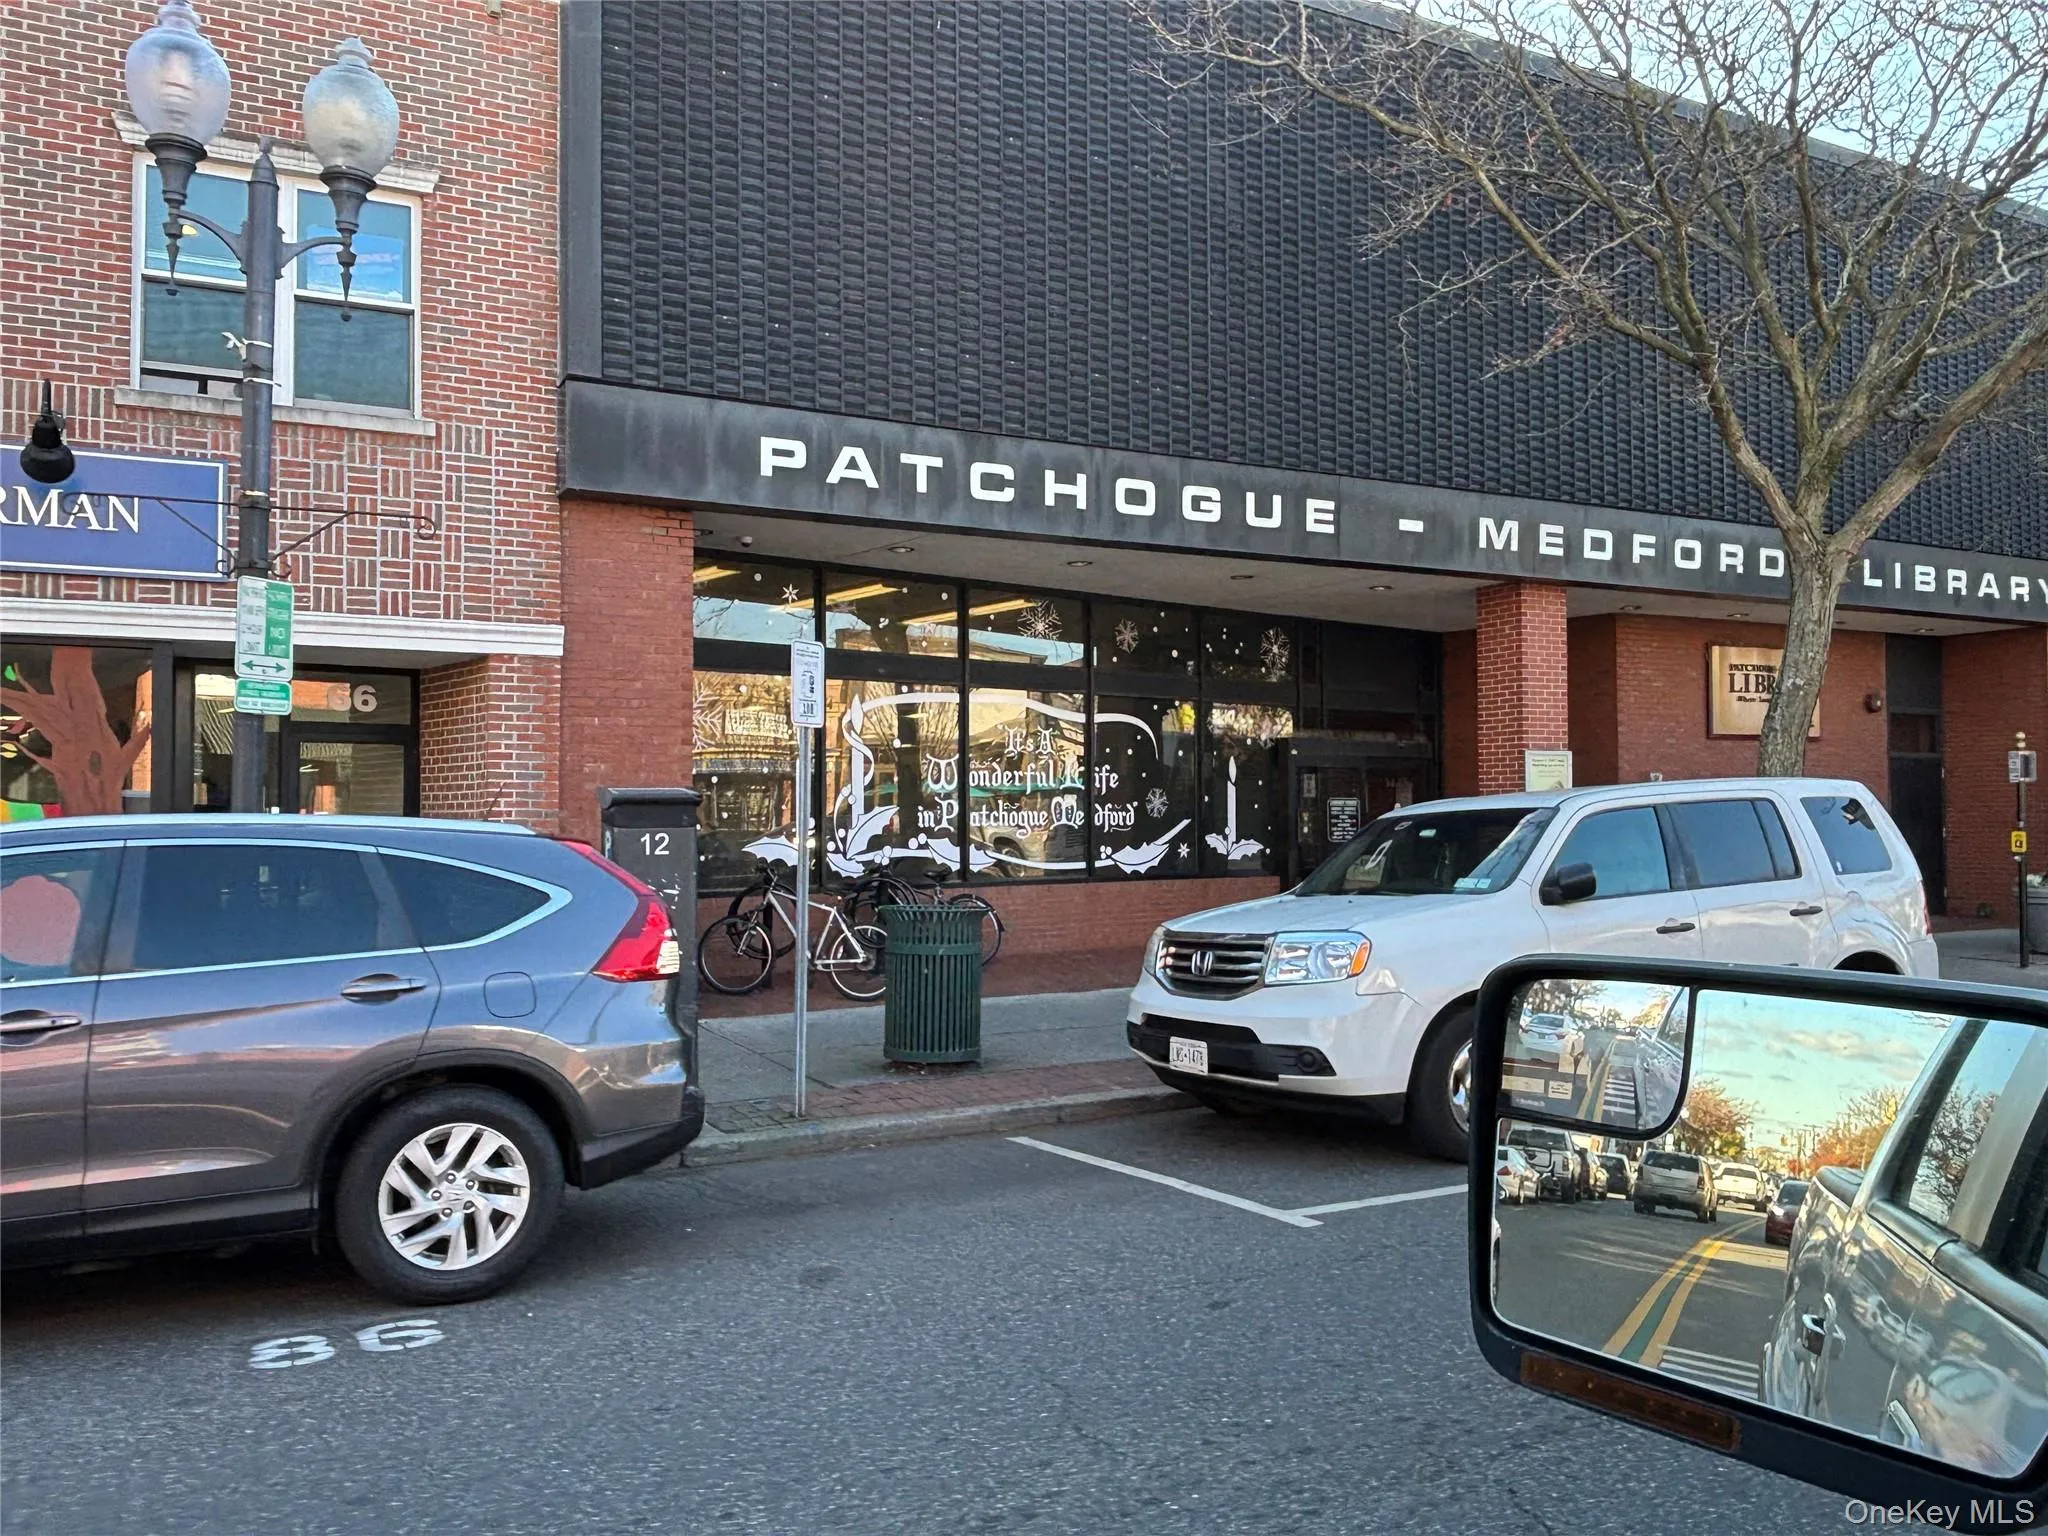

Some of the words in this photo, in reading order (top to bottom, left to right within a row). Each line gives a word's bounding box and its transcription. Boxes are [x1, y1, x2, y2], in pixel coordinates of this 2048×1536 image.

[760, 436, 1335, 534] PATCHOGUE
[1479, 517, 1784, 578] MEDFORD
[1728, 673, 1777, 695] LIBR
[925, 752, 1056, 795] Wonderful
[1060, 755, 1119, 795] Life
[917, 805, 935, 828] in
[934, 796, 1049, 839] Patchogue
[640, 832, 670, 856] 12
